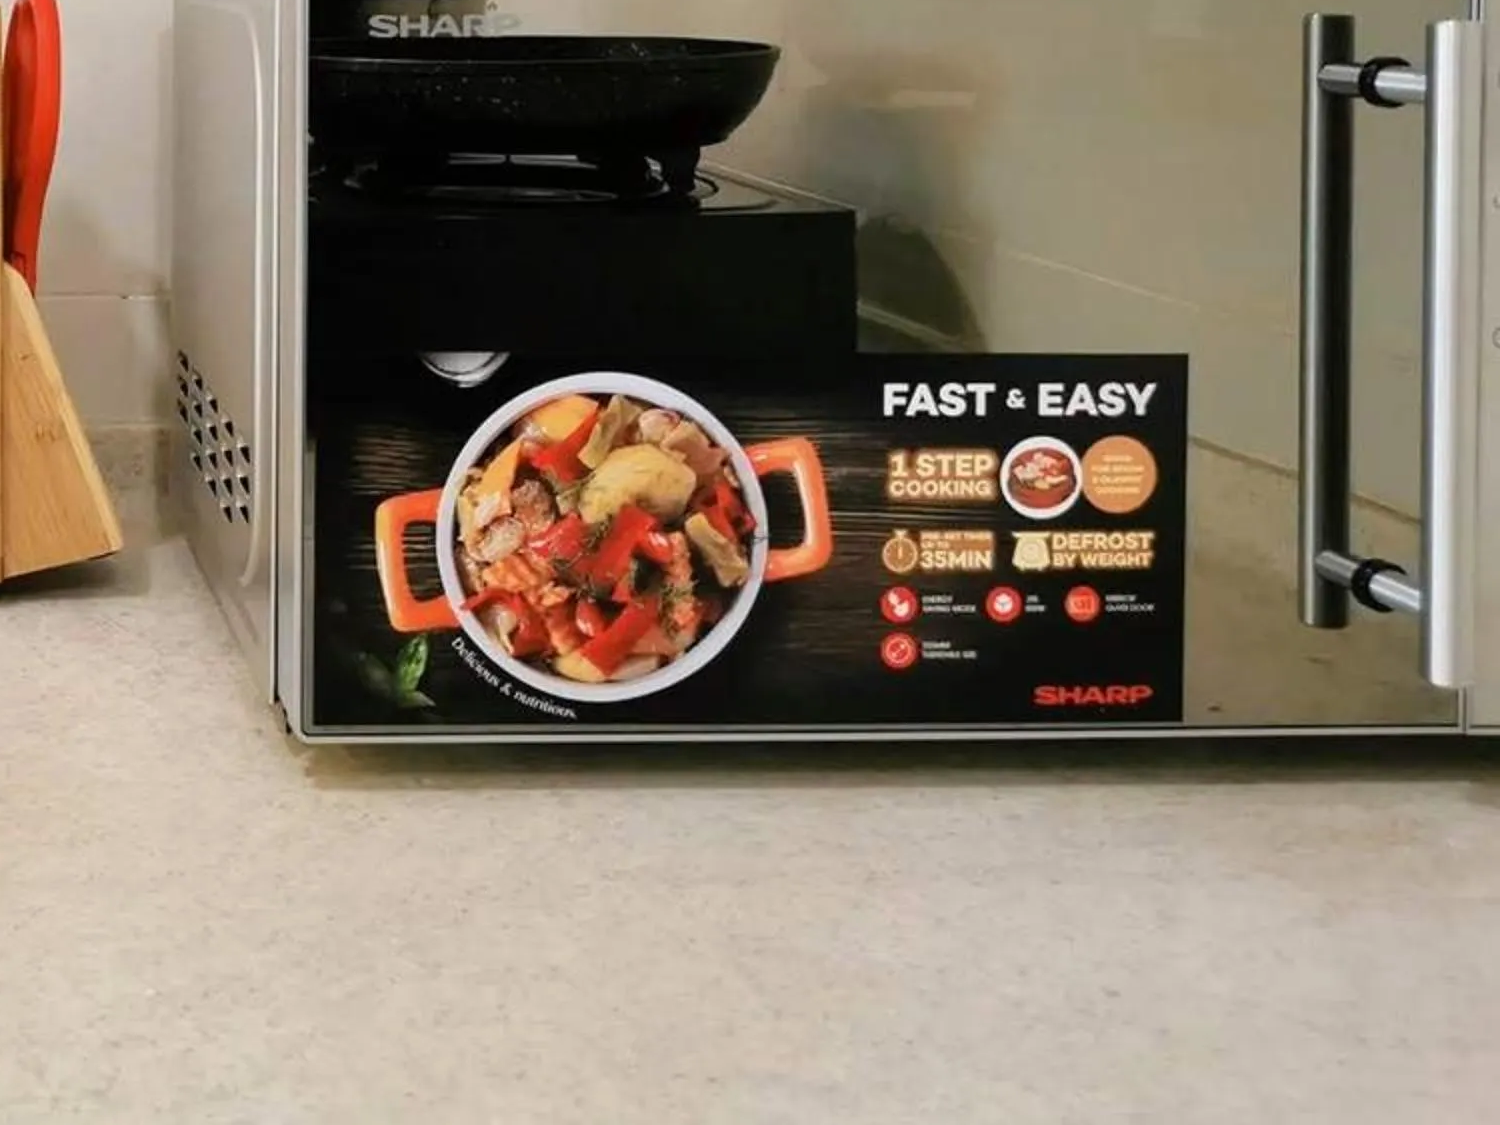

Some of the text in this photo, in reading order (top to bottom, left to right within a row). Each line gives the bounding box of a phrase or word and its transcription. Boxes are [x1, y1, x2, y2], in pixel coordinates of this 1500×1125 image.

[368, 14, 522, 38] SHARP
[883, 382, 1157, 417] FAST & EASY
[890, 454, 994, 477] 1 STEP
[889, 479, 991, 498] COOKING
[1053, 532, 1155, 550] DEFROST
[920, 551, 993, 570] 35MIN
[1053, 551, 1154, 568] BY WEIGHT
[451, 637, 500, 688] Delicious
[499, 683, 512, 696] &
[1033, 685, 1153, 704] SHARP
